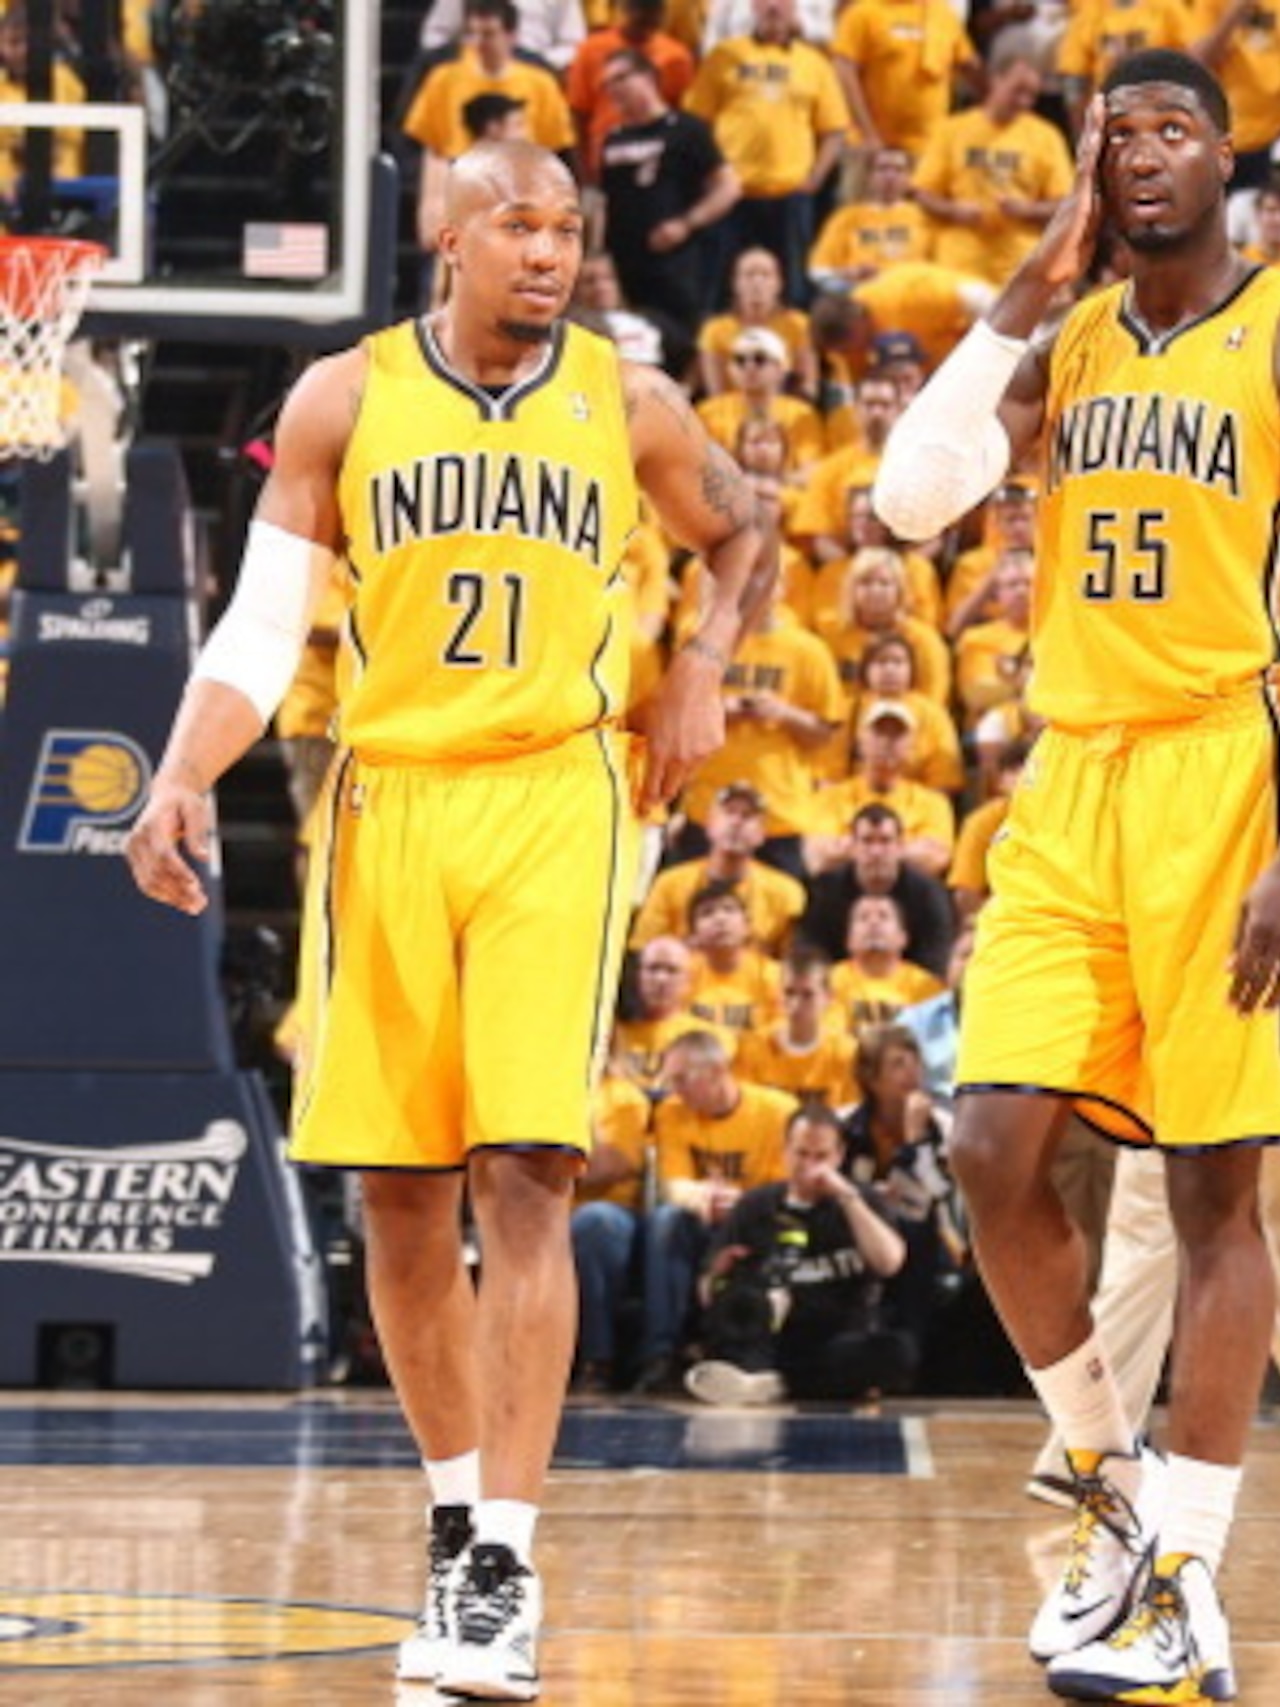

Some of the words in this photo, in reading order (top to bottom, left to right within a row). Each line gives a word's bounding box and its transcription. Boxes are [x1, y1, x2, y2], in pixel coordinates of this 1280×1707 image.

[368, 450, 601, 568] INDIANA
[1084, 511, 1166, 600] 55
[38, 612, 150, 646] SPALDING
[443, 570, 523, 669] 21
[0, 1201, 222, 1228] ONFERENCE
[2, 1225, 174, 1252] FINALS
